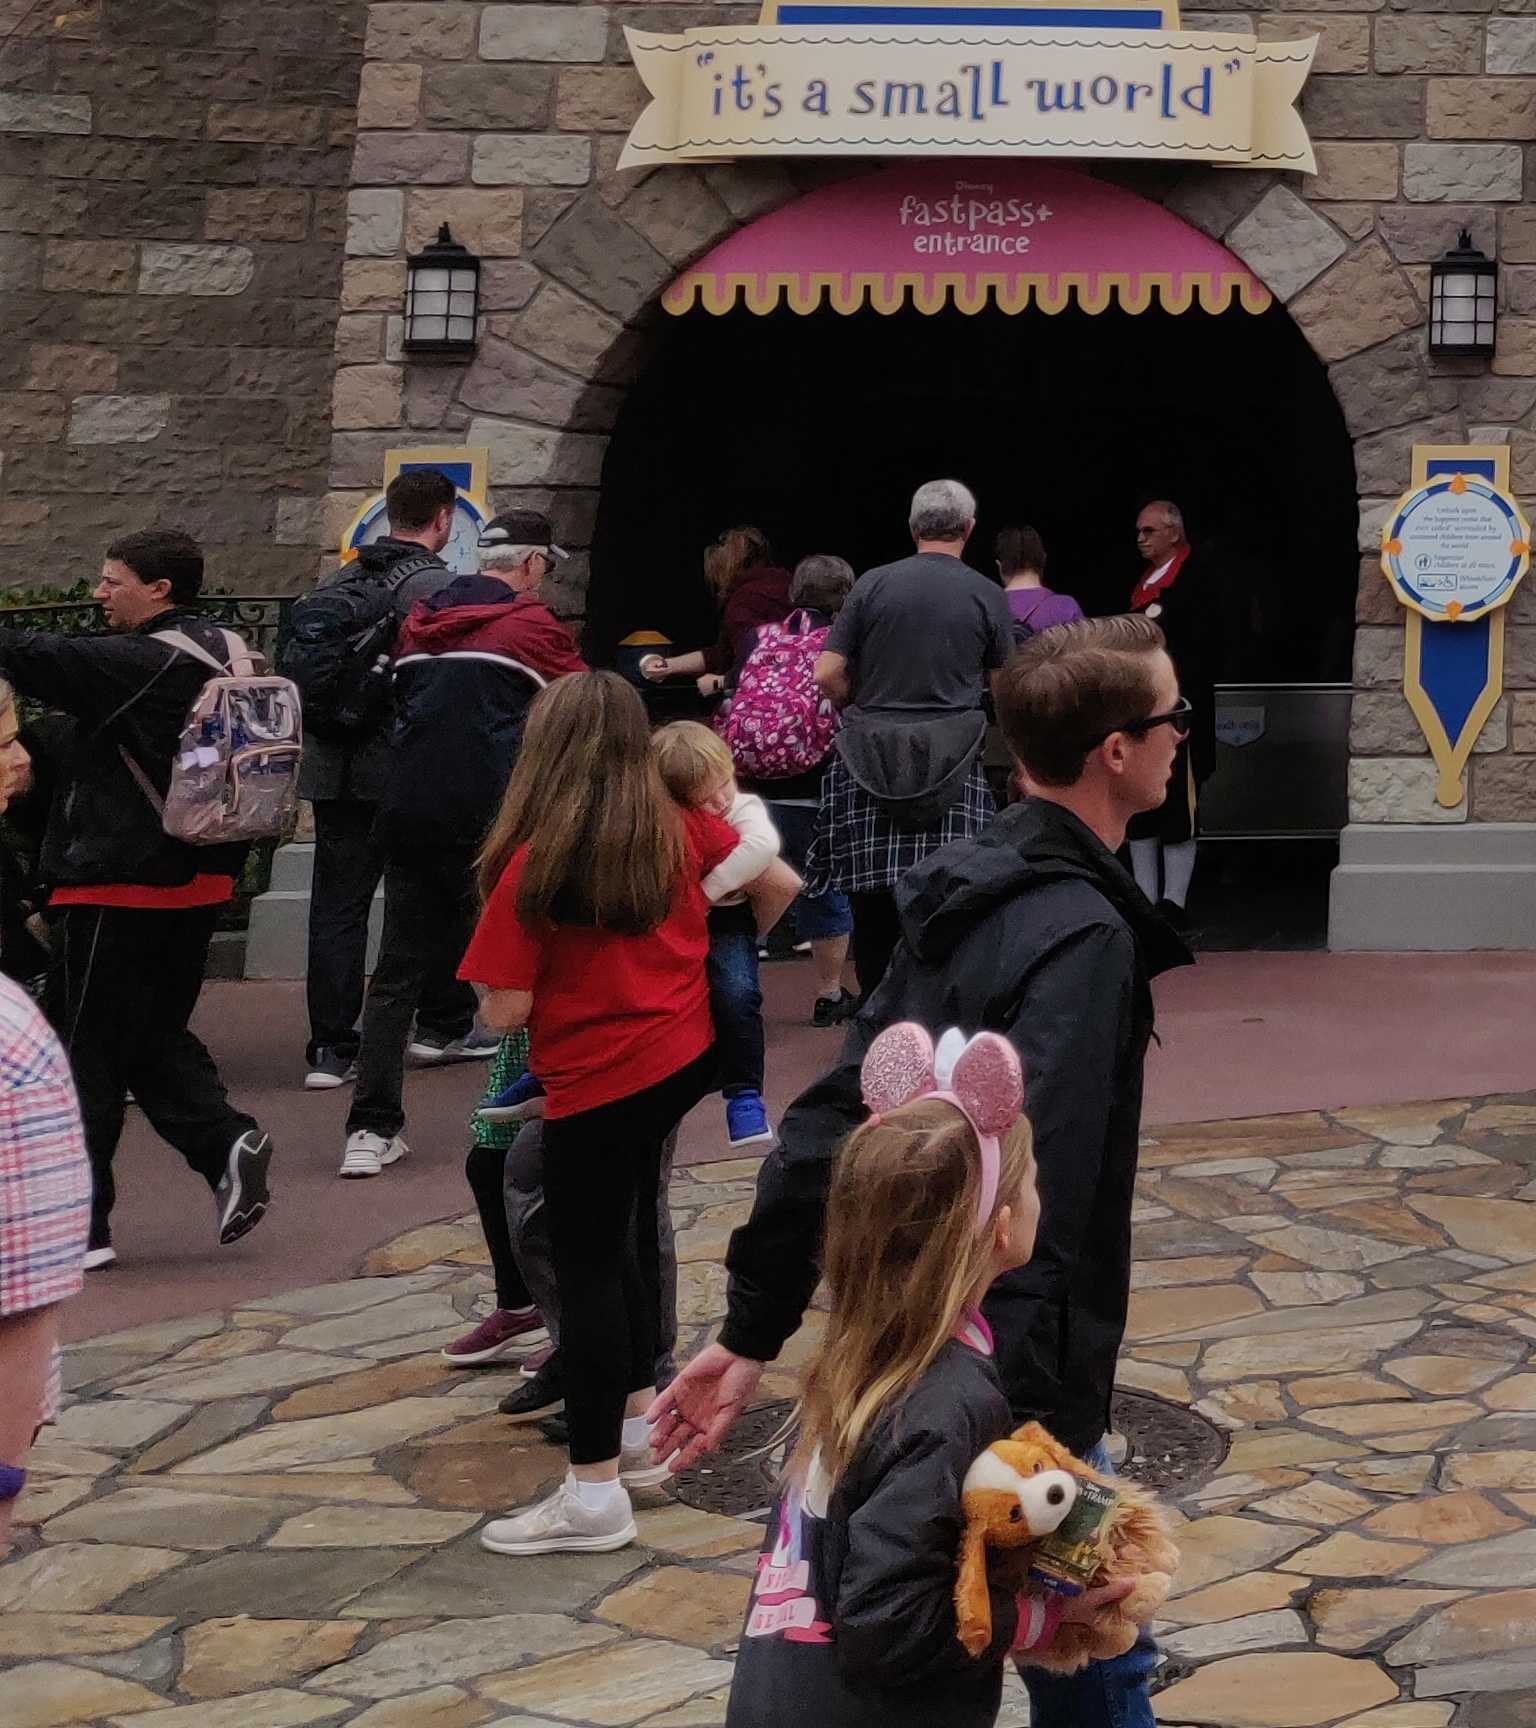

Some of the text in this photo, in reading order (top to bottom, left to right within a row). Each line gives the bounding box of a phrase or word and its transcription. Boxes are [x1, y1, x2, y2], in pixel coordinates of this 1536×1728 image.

[801, 76, 830, 118] a
[848, 60, 1009, 122] small
[912, 231, 1031, 256] entrance
